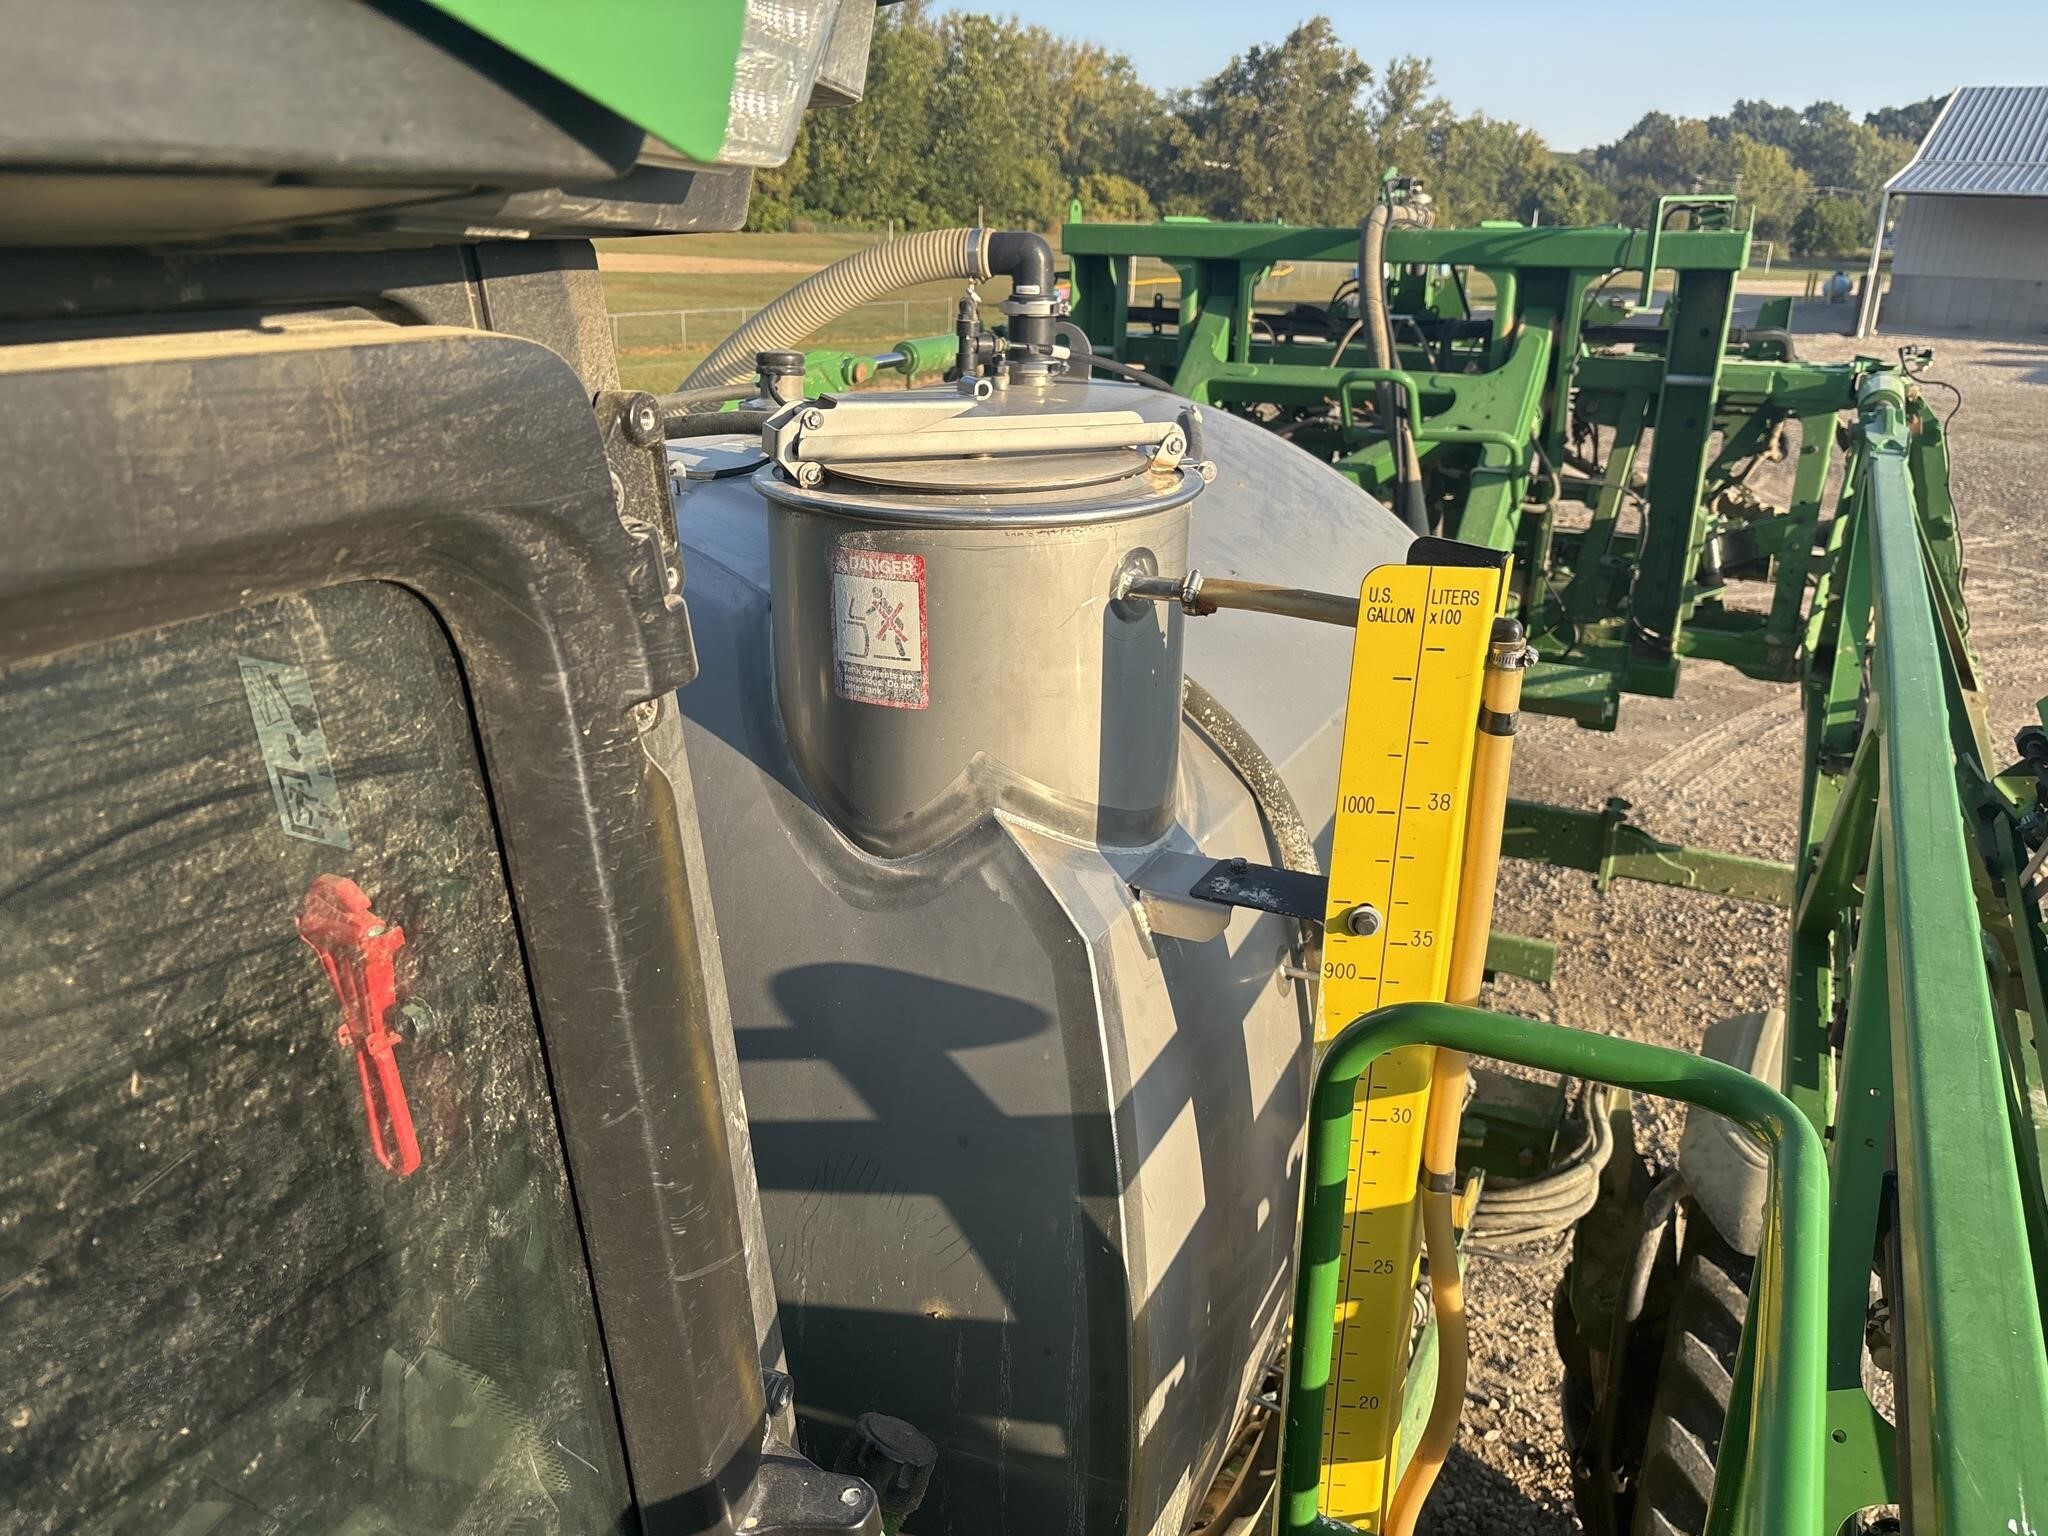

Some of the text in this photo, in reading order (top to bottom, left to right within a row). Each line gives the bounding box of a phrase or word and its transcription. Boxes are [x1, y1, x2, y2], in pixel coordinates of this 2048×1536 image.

[849, 556, 914, 576] DANGER
[1368, 586, 1393, 604] U.S.
[1431, 588, 1480, 606] LITERS
[1367, 606, 1415, 624] GALLON
[1429, 608, 1462, 625] x100
[862, 668, 898, 680] contents
[899, 673, 914, 681] are
[887, 680, 899, 688] Do
[900, 682, 915, 690] not
[1342, 795, 1375, 814] 1000
[1427, 793, 1451, 811] 38
[1410, 930, 1433, 948] 35
[1323, 962, 1356, 980] 900
[1390, 1107, 1412, 1124] 30
[1373, 1259, 1394, 1274] 25
[1359, 1395, 1379, 1410] 20
